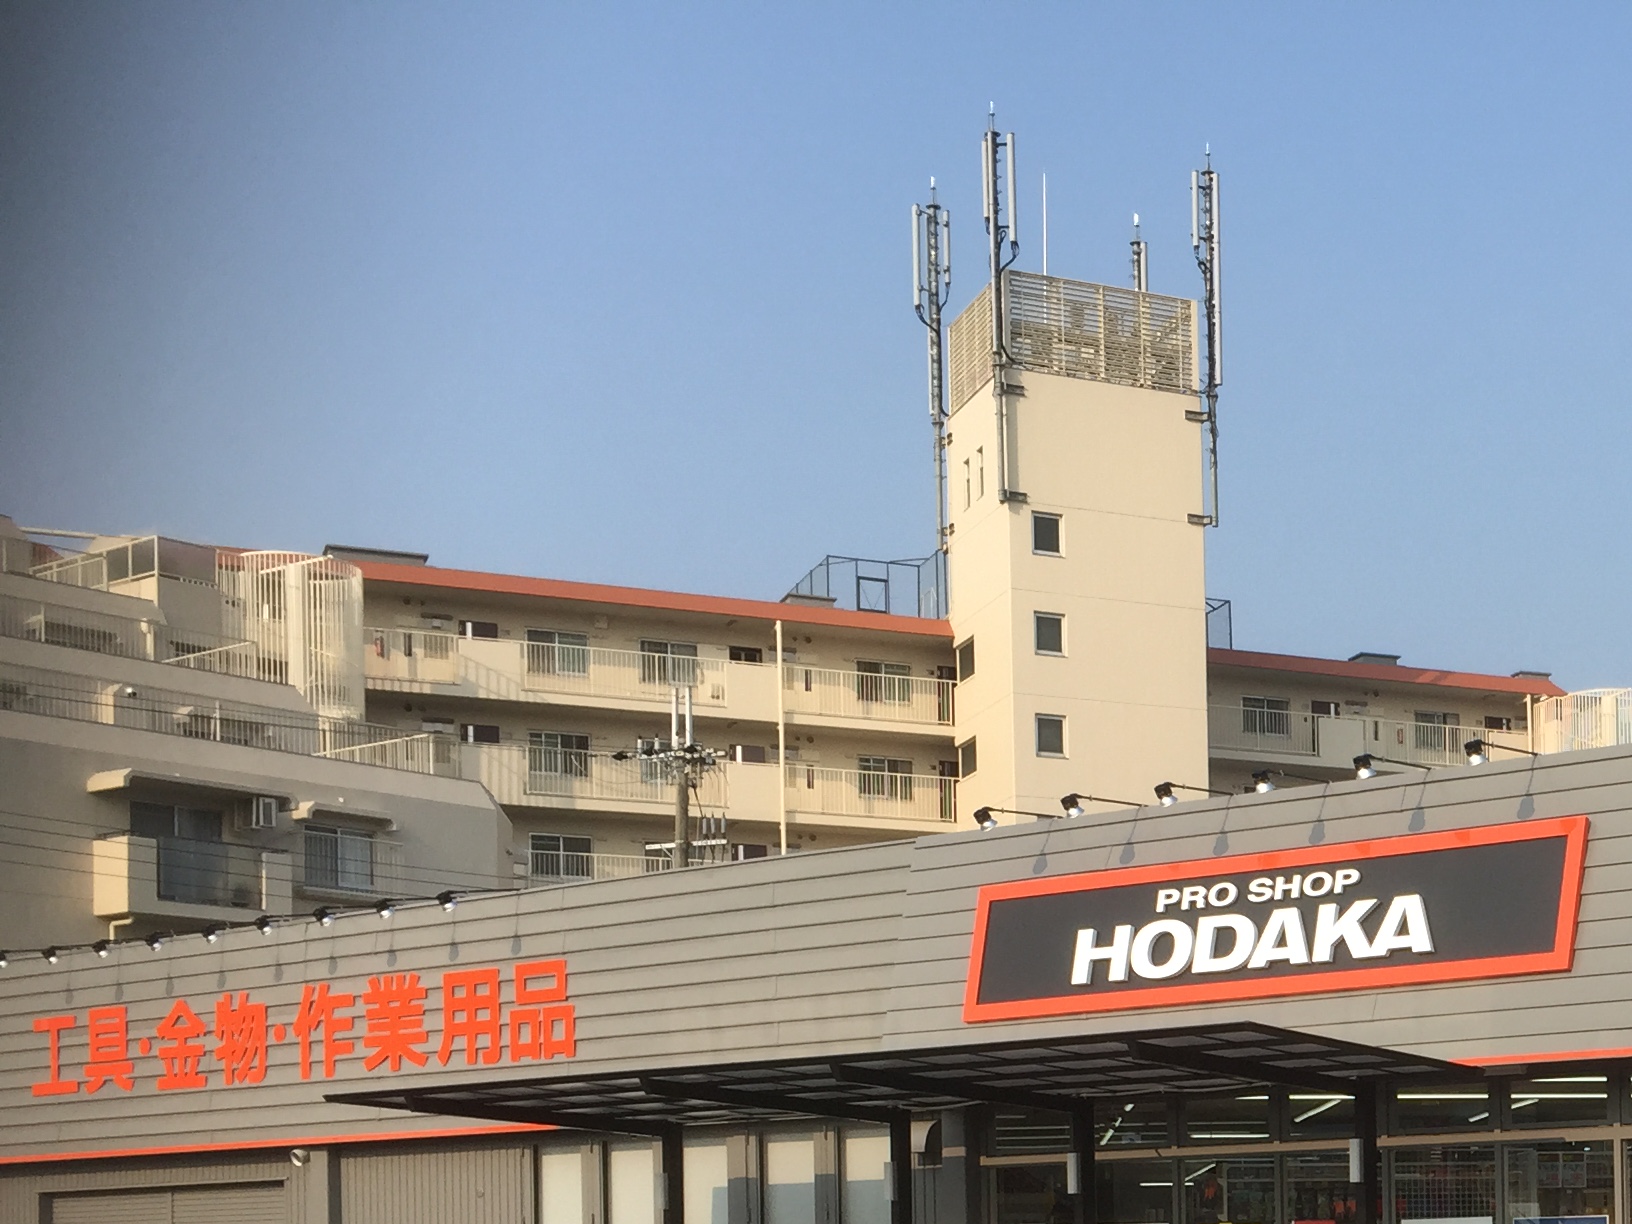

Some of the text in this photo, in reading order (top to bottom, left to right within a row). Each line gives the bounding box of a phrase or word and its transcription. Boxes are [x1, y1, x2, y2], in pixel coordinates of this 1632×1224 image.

[1156, 868, 1363, 913] PRO SHOP
[1071, 894, 1434, 986] HODAKA
